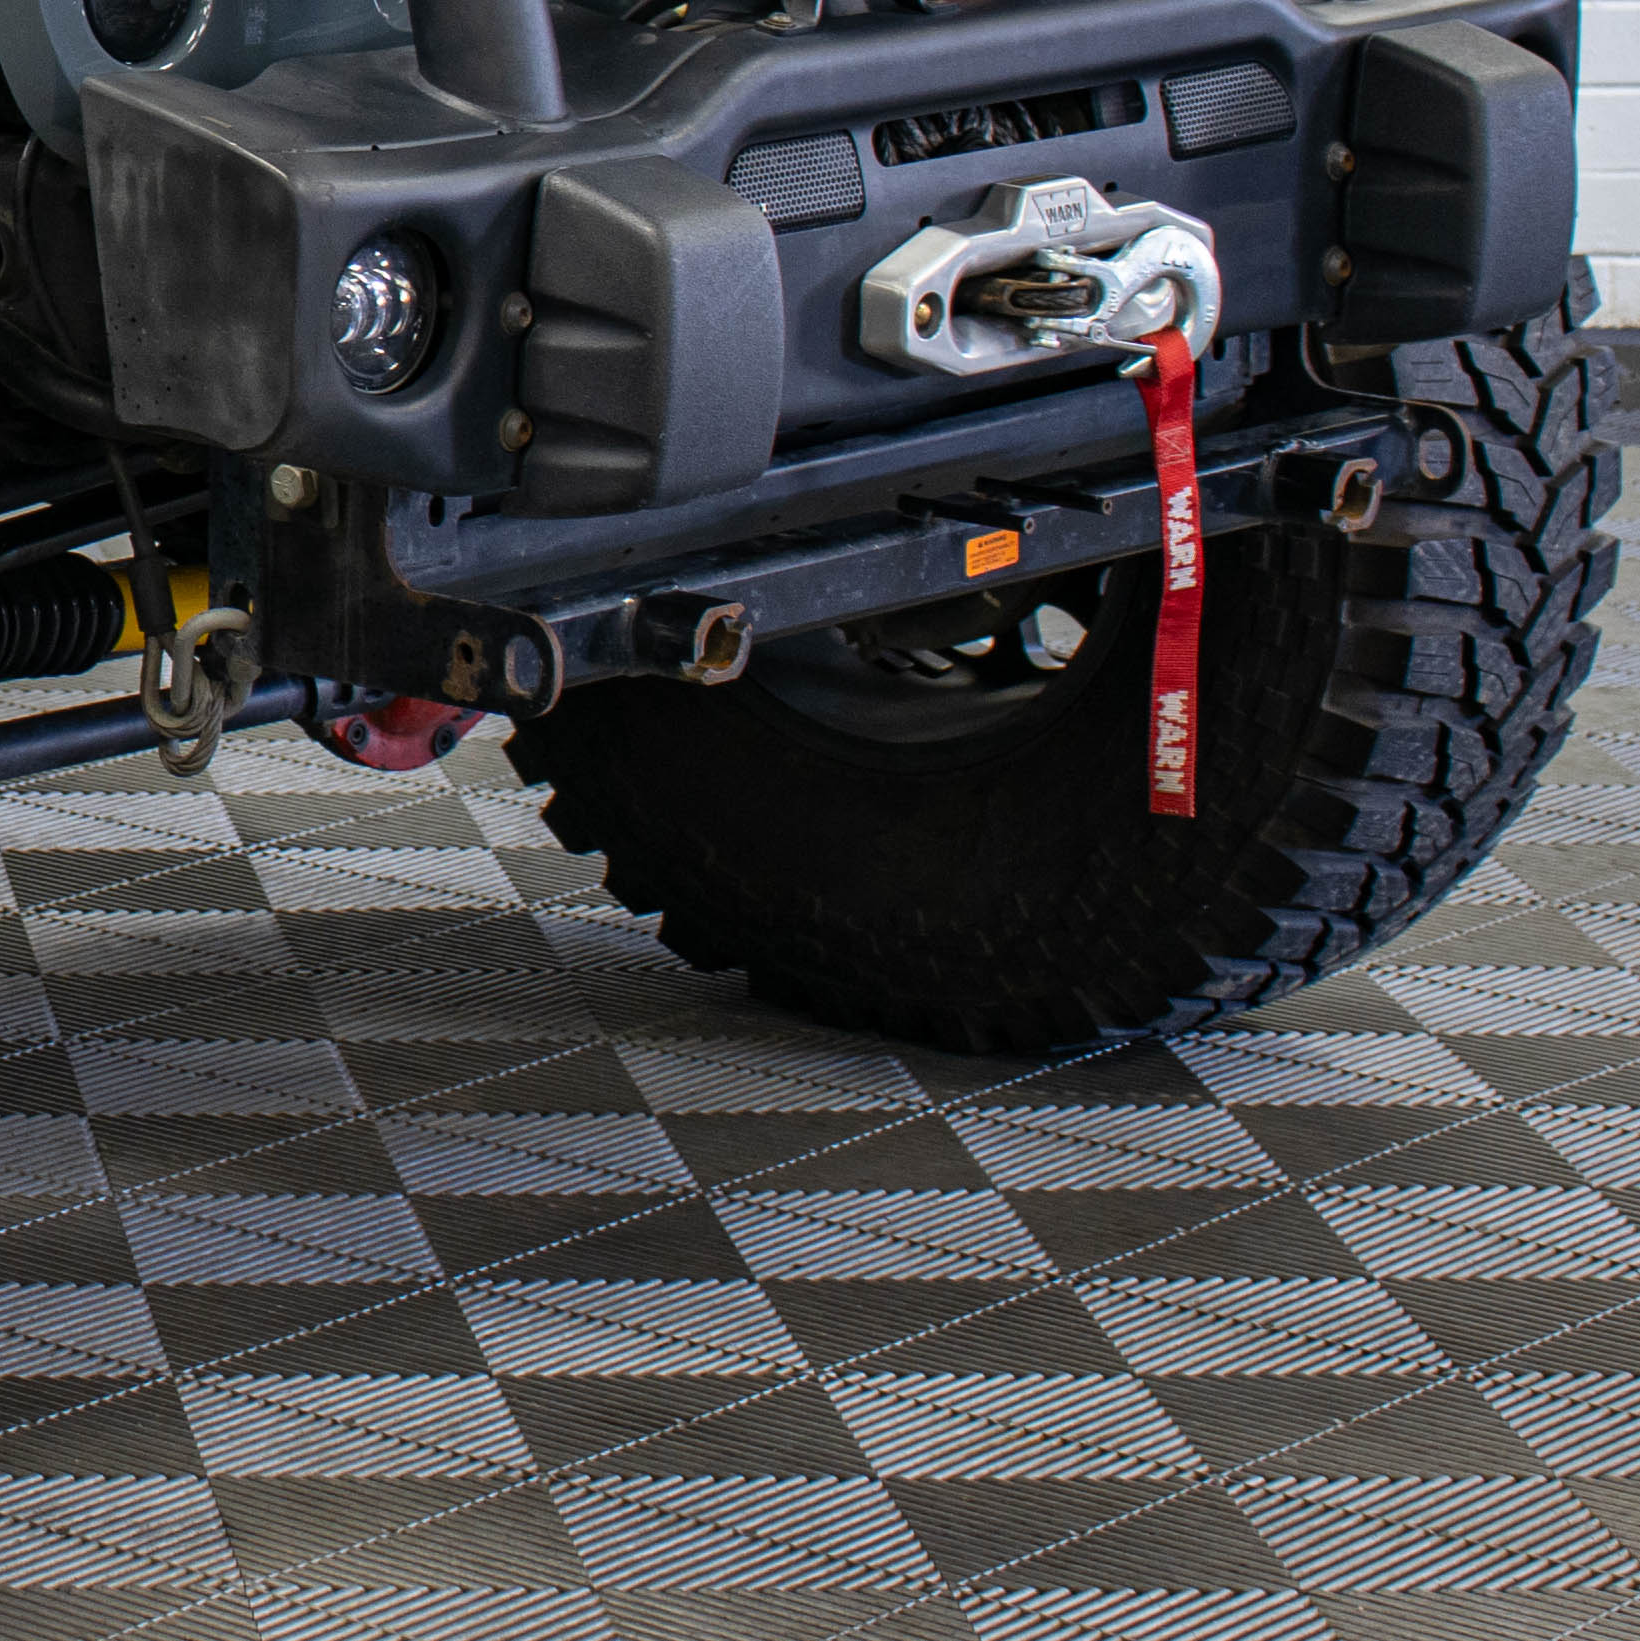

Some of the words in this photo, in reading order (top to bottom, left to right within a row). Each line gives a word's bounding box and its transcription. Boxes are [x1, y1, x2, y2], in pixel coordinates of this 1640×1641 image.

[1045, 201, 1083, 224] WARN
[1167, 486, 1198, 592] WARN
[1153, 689, 1189, 795] WARN
